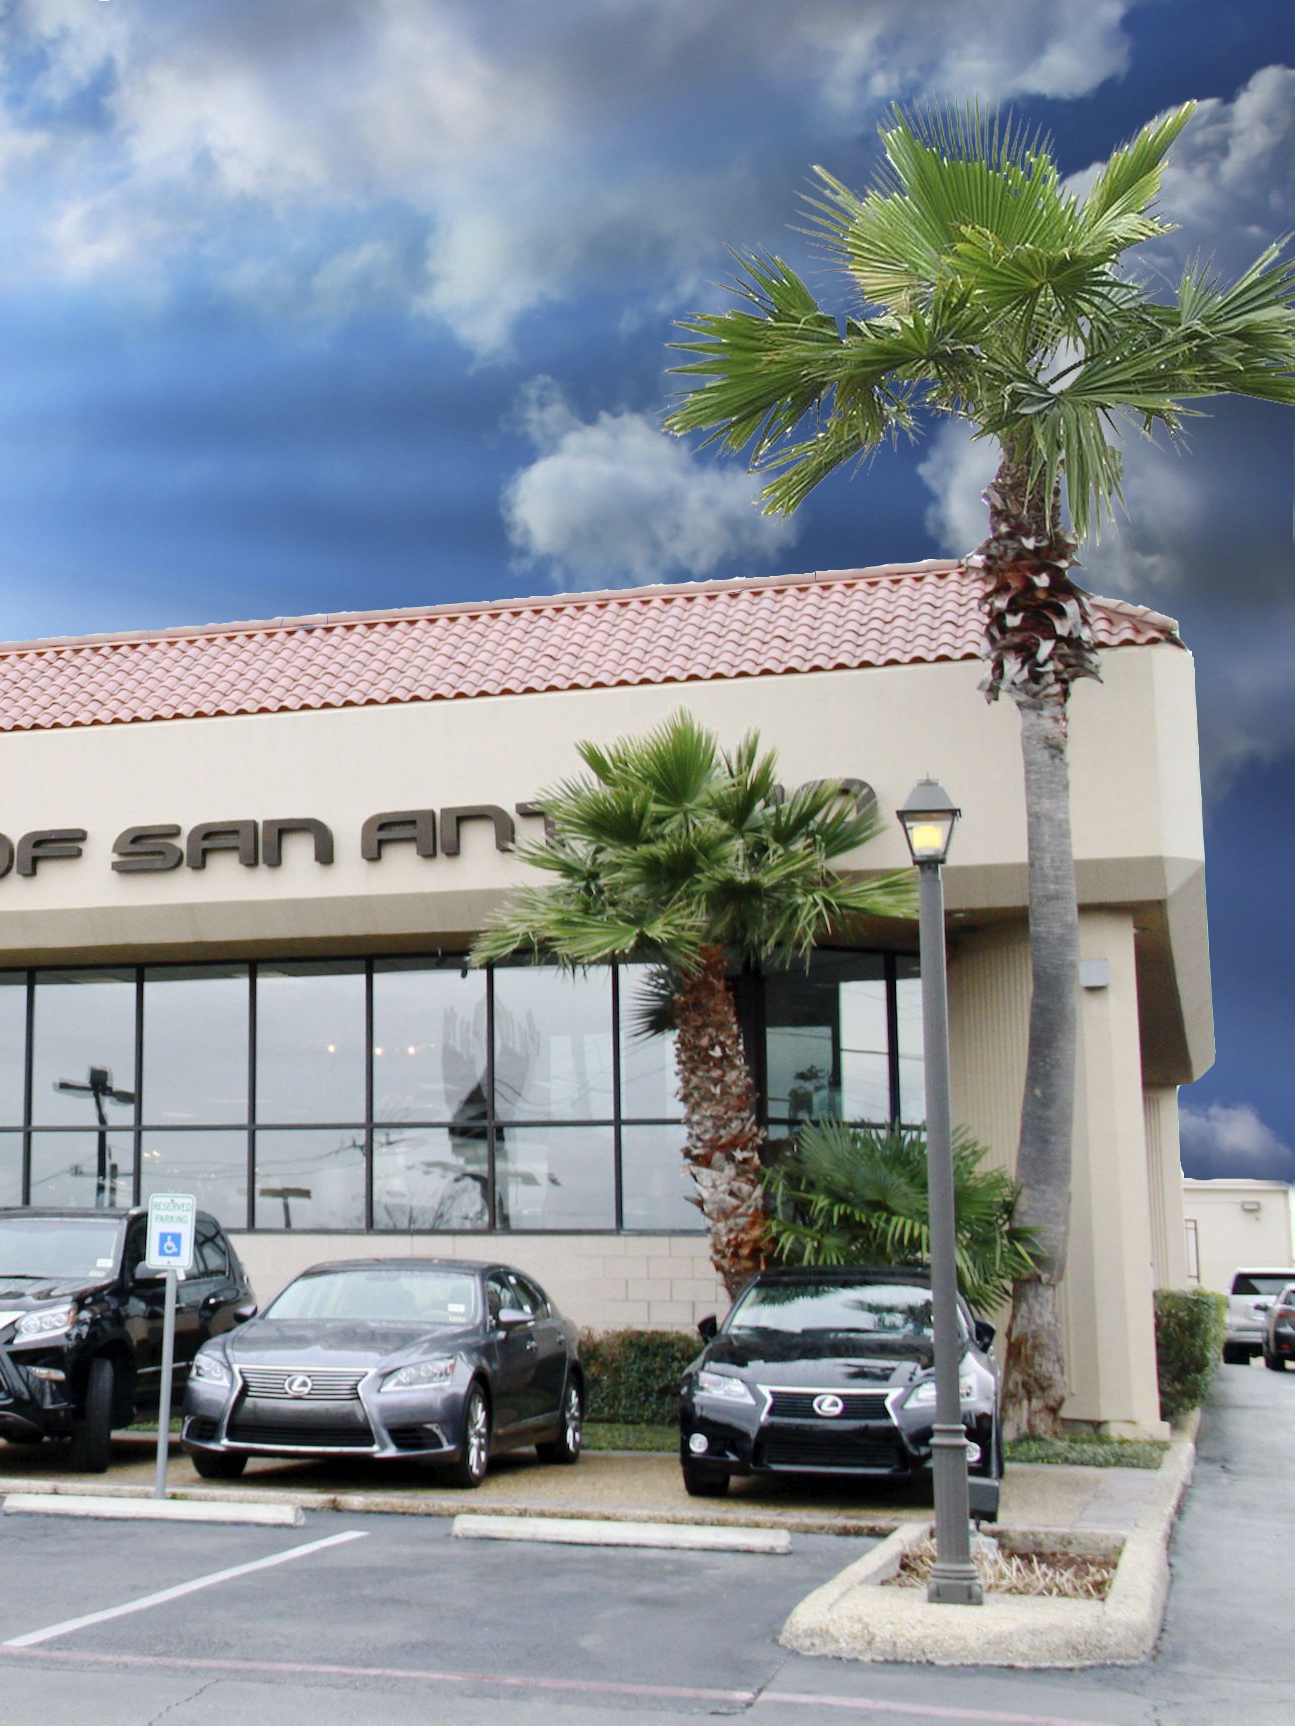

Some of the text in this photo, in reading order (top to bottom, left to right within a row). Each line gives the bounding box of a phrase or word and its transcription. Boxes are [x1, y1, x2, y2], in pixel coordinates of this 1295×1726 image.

[111, 817, 335, 873] SAN
[153, 1200, 191, 1212] RESERVED
[155, 1214, 188, 1224] PARKING
